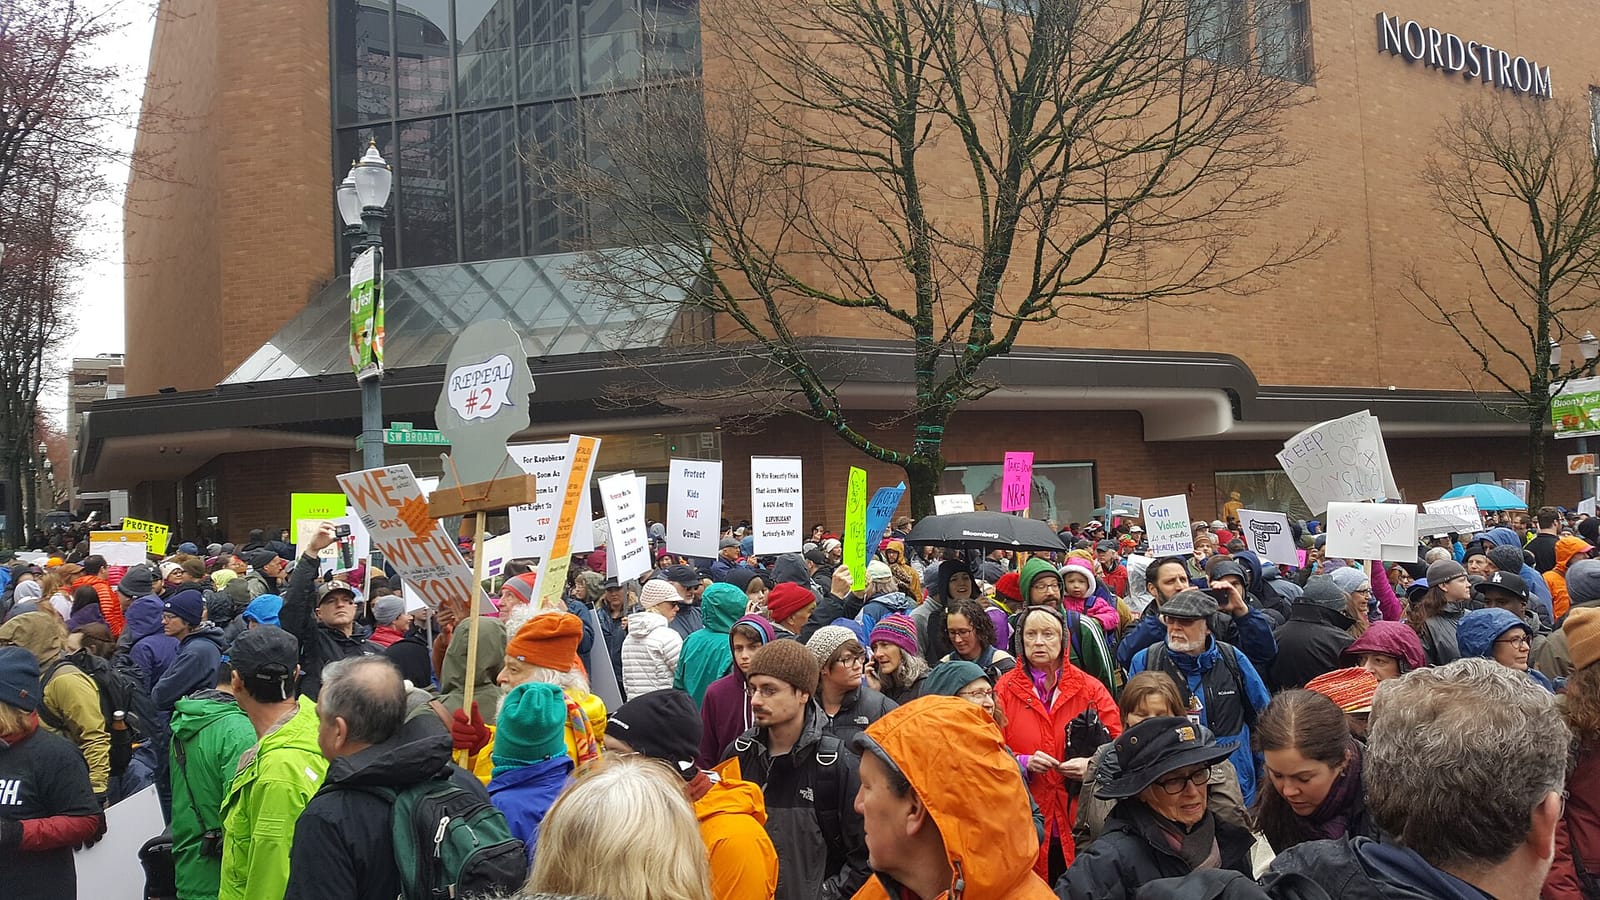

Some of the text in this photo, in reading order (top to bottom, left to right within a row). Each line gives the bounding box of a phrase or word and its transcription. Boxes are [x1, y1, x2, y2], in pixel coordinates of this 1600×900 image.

[1377, 12, 1552, 98] NORDSTROM
[453, 363, 511, 391] REPEAL
[465, 387, 492, 414] #2
[390, 432, 449, 443] SW BROADWA
[1281, 416, 1367, 468] KEEP GUNS
[1007, 458, 1020, 472] TAKE
[1292, 452, 1334, 483] OUT
[683, 468, 706, 479] Protect
[343, 470, 402, 512] WE
[687, 489, 700, 499] Kids
[1007, 484, 1026, 508] NRA
[528, 503, 545, 511] Right
[686, 509, 698, 518] NOT
[1148, 504, 1170, 518] Gun
[1427, 504, 1462, 515] PROTECT
[126, 520, 166, 534] PROTECT
[380, 519, 402, 530] are
[1156, 520, 1187, 531] Violence
[1335, 508, 1360, 533] ARMS
[1374, 507, 1408, 541] HUGS
[962, 530, 999, 538] Bloomberg
[376, 535, 461, 567] WITH
[1152, 542, 1193, 553] HEALTH ISSUE
[407, 576, 472, 606] YOU
